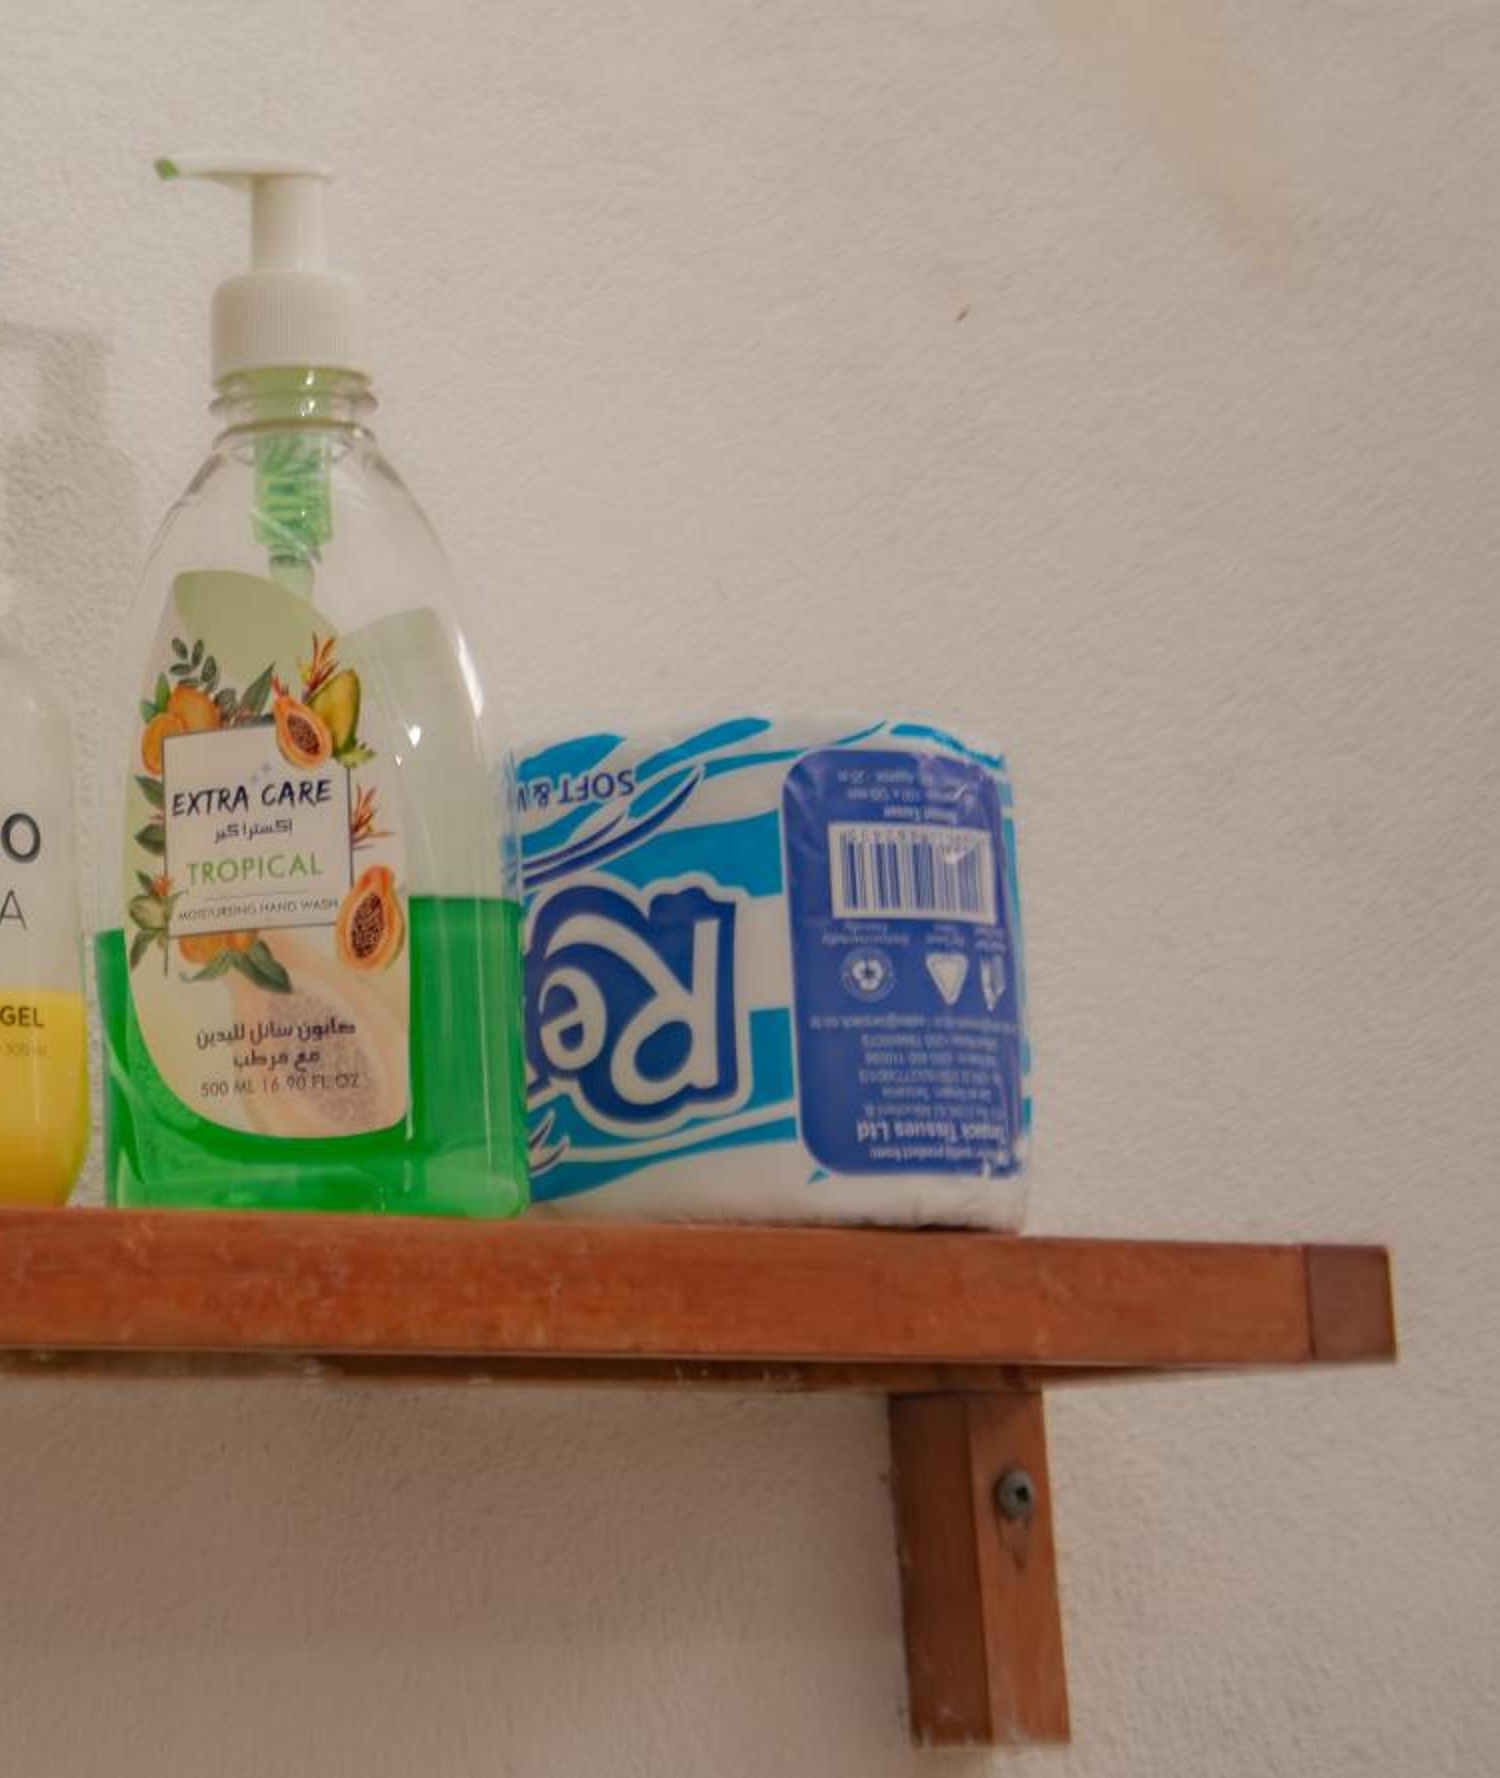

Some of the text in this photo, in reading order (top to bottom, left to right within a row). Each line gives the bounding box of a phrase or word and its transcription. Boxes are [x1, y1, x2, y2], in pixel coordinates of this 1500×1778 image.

[171, 779, 332, 817] EXTRA CARE
[532, 781, 550, 809] &
[557, 768, 636, 805] SOFT
[186, 851, 325, 887] TROPICAL
[0, 1004, 46, 1029] GEL
[293, 1050, 321, 1072] مع
[200, 1080, 229, 1098] 500
[855, 1119, 890, 1144] Ltd
